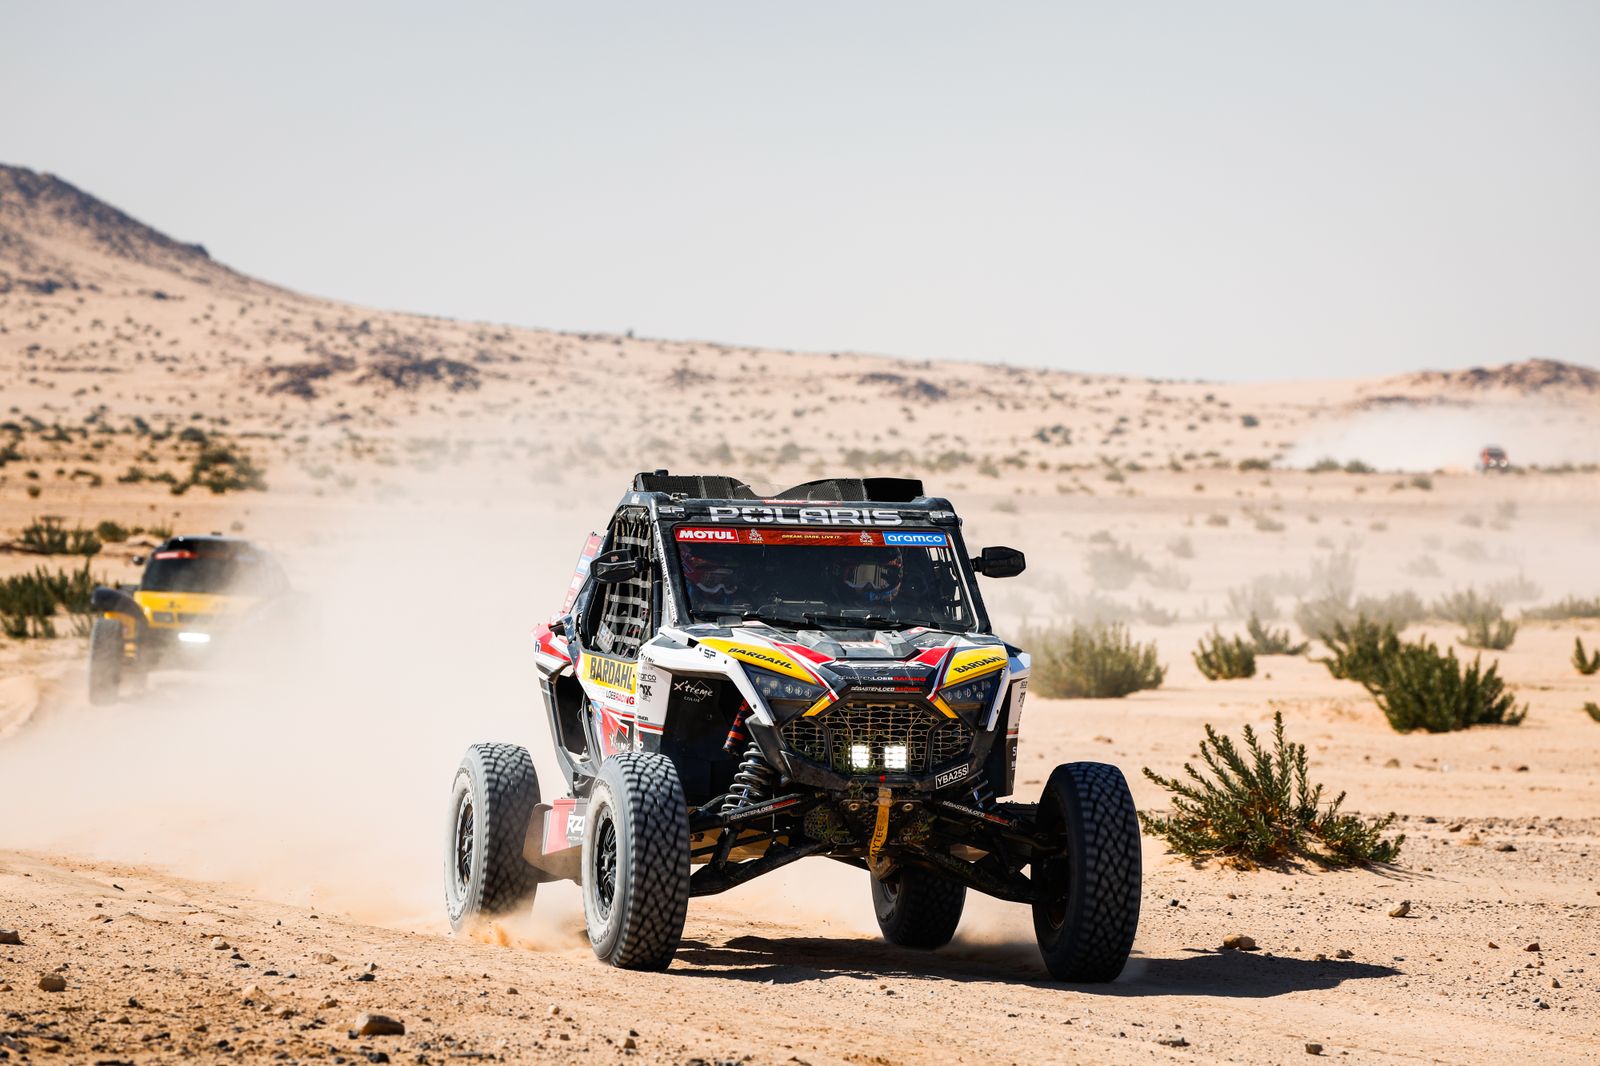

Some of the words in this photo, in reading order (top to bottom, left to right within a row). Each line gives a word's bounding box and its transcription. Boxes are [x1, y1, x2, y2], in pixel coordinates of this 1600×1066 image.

[709, 506, 903, 526] POLARIS
[679, 530, 735, 540] MOTUL
[887, 534, 943, 543] aramco
[728, 647, 793, 670] BARDAHL
[953, 655, 1006, 673] BARDAHL
[589, 657, 633, 691] BARDAHL
[936, 766, 968, 786] YBA25S
